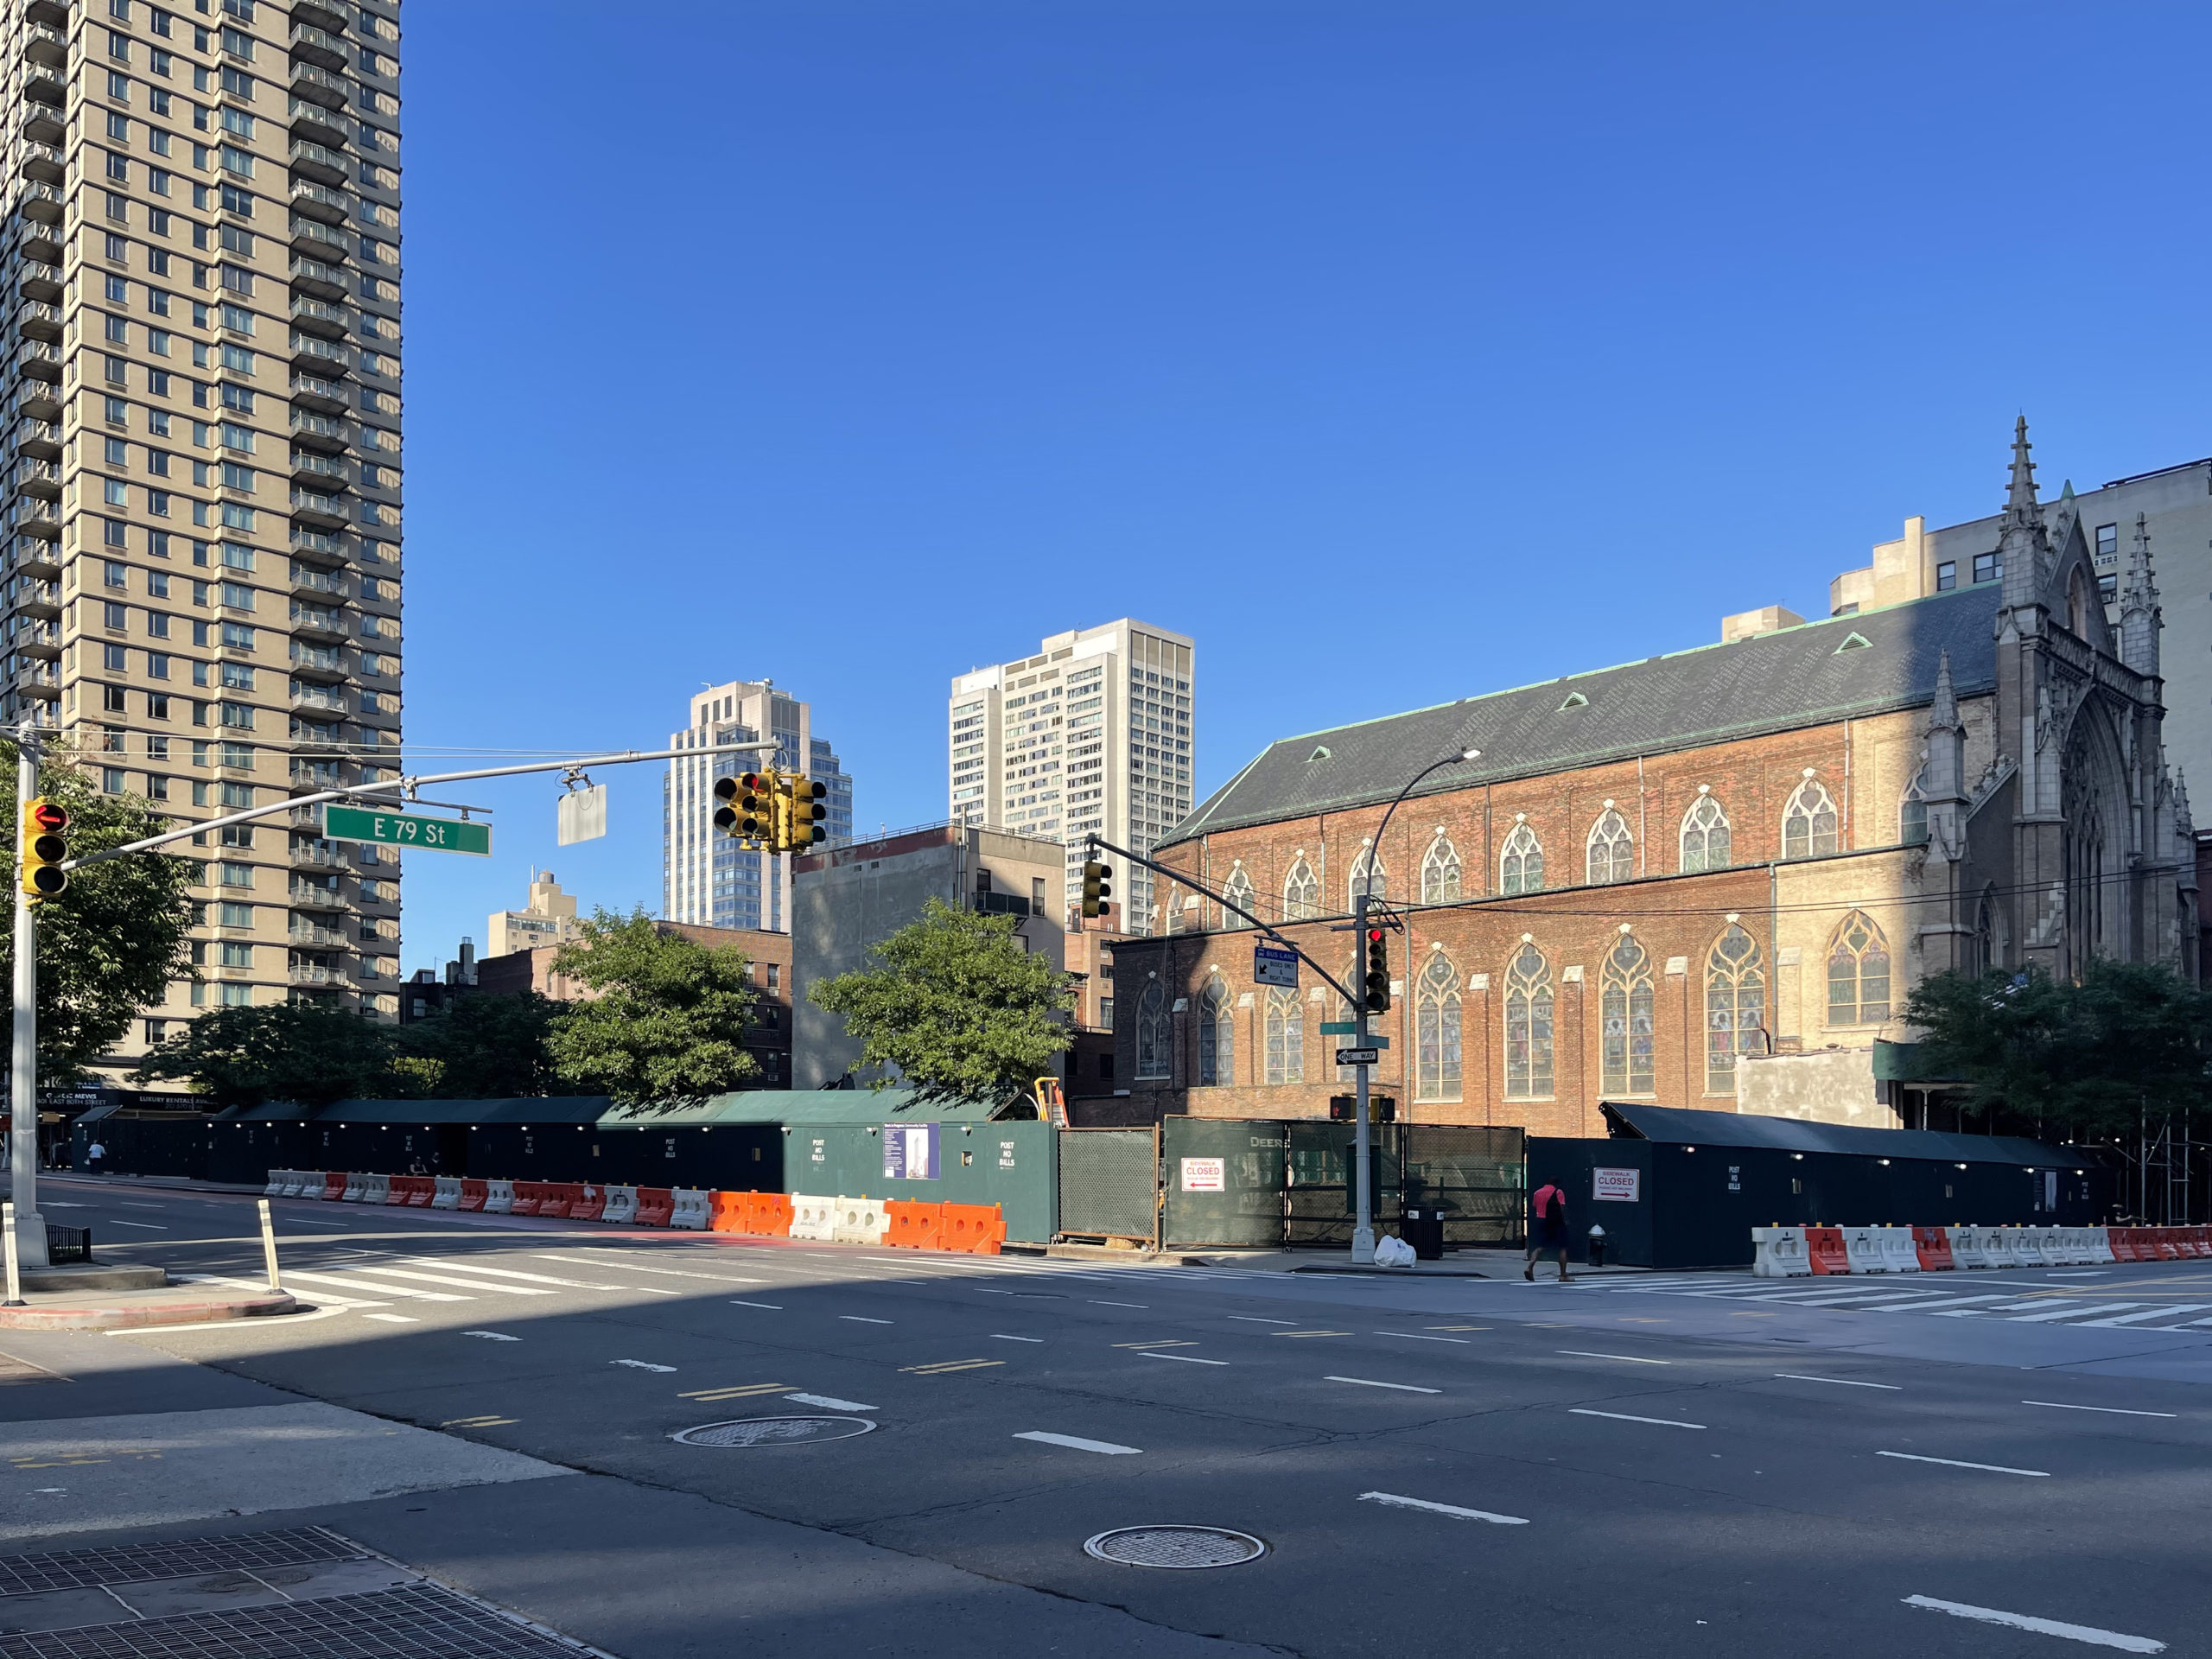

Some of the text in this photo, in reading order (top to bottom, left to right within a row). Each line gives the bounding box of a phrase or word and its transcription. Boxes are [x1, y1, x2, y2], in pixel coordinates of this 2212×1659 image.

[374, 817, 445, 844] E 79 St
[1360, 1052, 1375, 1060] WAY
[999, 1158, 1014, 1166] BILLS
[1599, 1177, 1634, 1185] CLOSED
